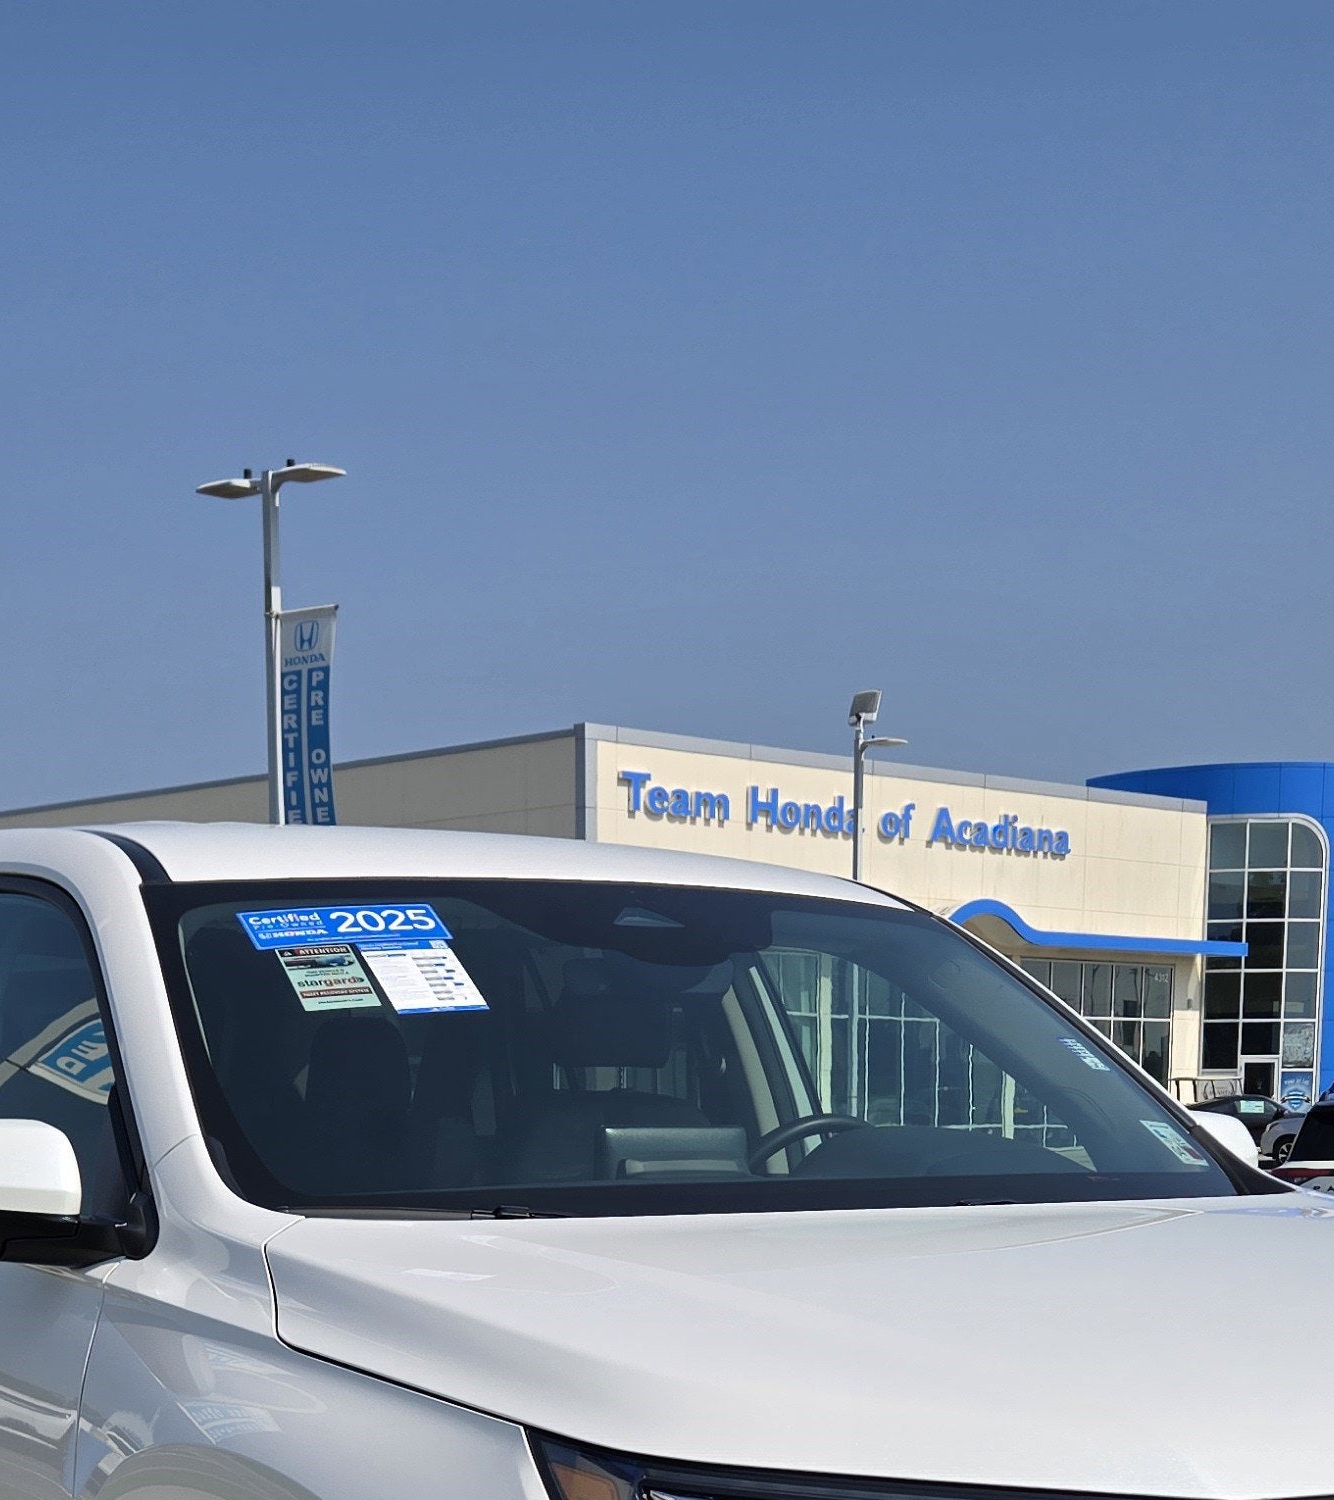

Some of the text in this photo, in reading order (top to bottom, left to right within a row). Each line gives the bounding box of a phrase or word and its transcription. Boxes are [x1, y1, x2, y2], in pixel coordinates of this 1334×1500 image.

[284, 653, 326, 667] HONDA
[310, 670, 331, 823] PRE OWNE
[619, 769, 731, 823] Team
[879, 802, 916, 840] of
[930, 806, 1072, 857] Acadiana
[249, 911, 321, 926] Certified
[329, 909, 436, 932] 2025
[272, 929, 329, 938] HONDA
[298, 946, 348, 956] ATTENTION
